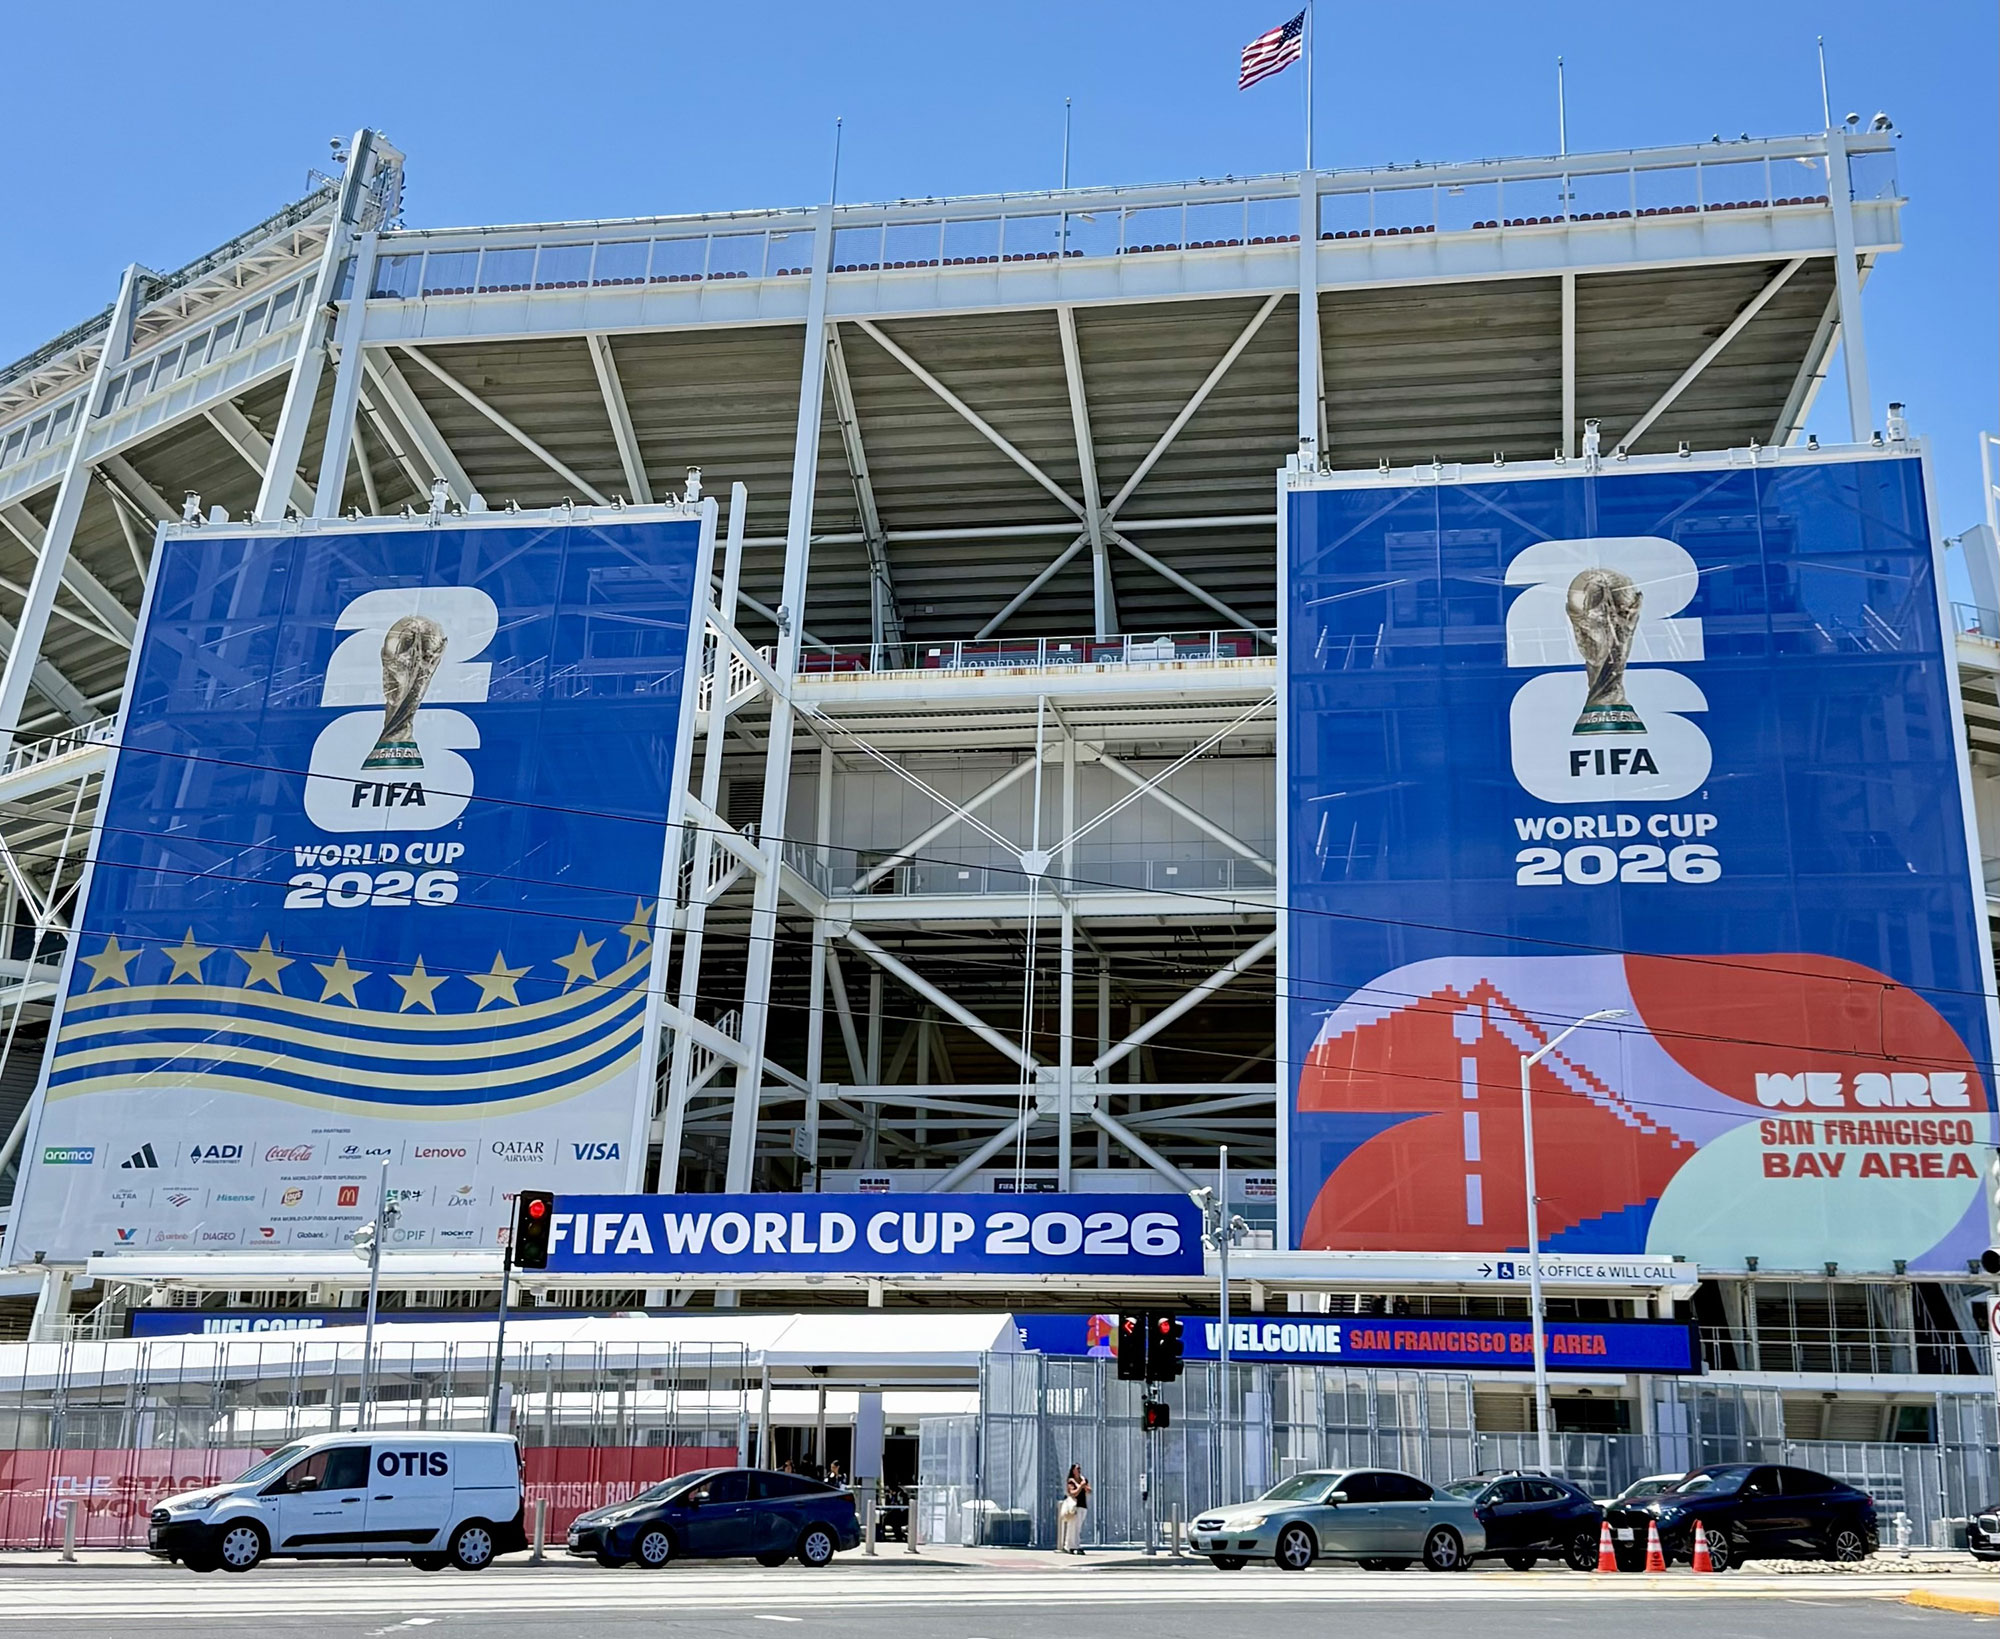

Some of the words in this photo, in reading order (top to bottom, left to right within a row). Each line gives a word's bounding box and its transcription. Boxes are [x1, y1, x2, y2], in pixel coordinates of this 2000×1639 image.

[1020, 657, 1074, 666] NAHOS
[1570, 748, 1659, 776] FIFA
[351, 782, 426, 808] FIFA
[1514, 814, 1641, 841] WORLD
[1647, 813, 1718, 838] CUP
[294, 843, 399, 867] WORLD
[404, 842, 465, 865] CUP
[1515, 844, 1722, 886] 2026
[283, 870, 460, 909] 2026
[1755, 1072, 1845, 1107] WE
[1853, 1072, 1971, 1107] ARE
[1760, 1119, 1815, 1145] SAN
[1824, 1119, 1974, 1145] FRANCISCO
[45, 1149, 93, 1161] aramco
[204, 1145, 243, 1158] ADI
[414, 1146, 467, 1158] Lenovo
[492, 1141, 544, 1155] QATAR
[570, 1142, 620, 1161] VISA
[503, 1154, 544, 1163] AIRWAYS
[1762, 1152, 1846, 1178] BAY
[1859, 1152, 1978, 1178] AREA
[216, 1194, 256, 1202] Hisense
[448, 1195, 476, 1207] Dove
[202, 1232, 236, 1241] DIAGEO
[407, 1230, 425, 1240] PIF
[547, 1213, 654, 1254] FIFA
[663, 1212, 857, 1254] WORLD
[866, 1211, 975, 1254] CUP
[985, 1212, 1181, 1255] 2026
[1548, 1265, 1592, 1277] OFFICE
[1596, 1266, 1606, 1277] &
[1609, 1266, 1641, 1278] WILL
[1644, 1266, 1677, 1279] CALL
[1204, 1323, 1342, 1353] WELCOME
[1349, 1330, 1391, 1350] SAN
[1394, 1331, 1506, 1352] FRANCISCO
[1553, 1334, 1607, 1355] AREA
[376, 1451, 449, 1477] OTIS
[51, 1475, 113, 1495] THE
[524, 1481, 602, 1509] RANCISCO
[84, 1498, 152, 1518] YOU
